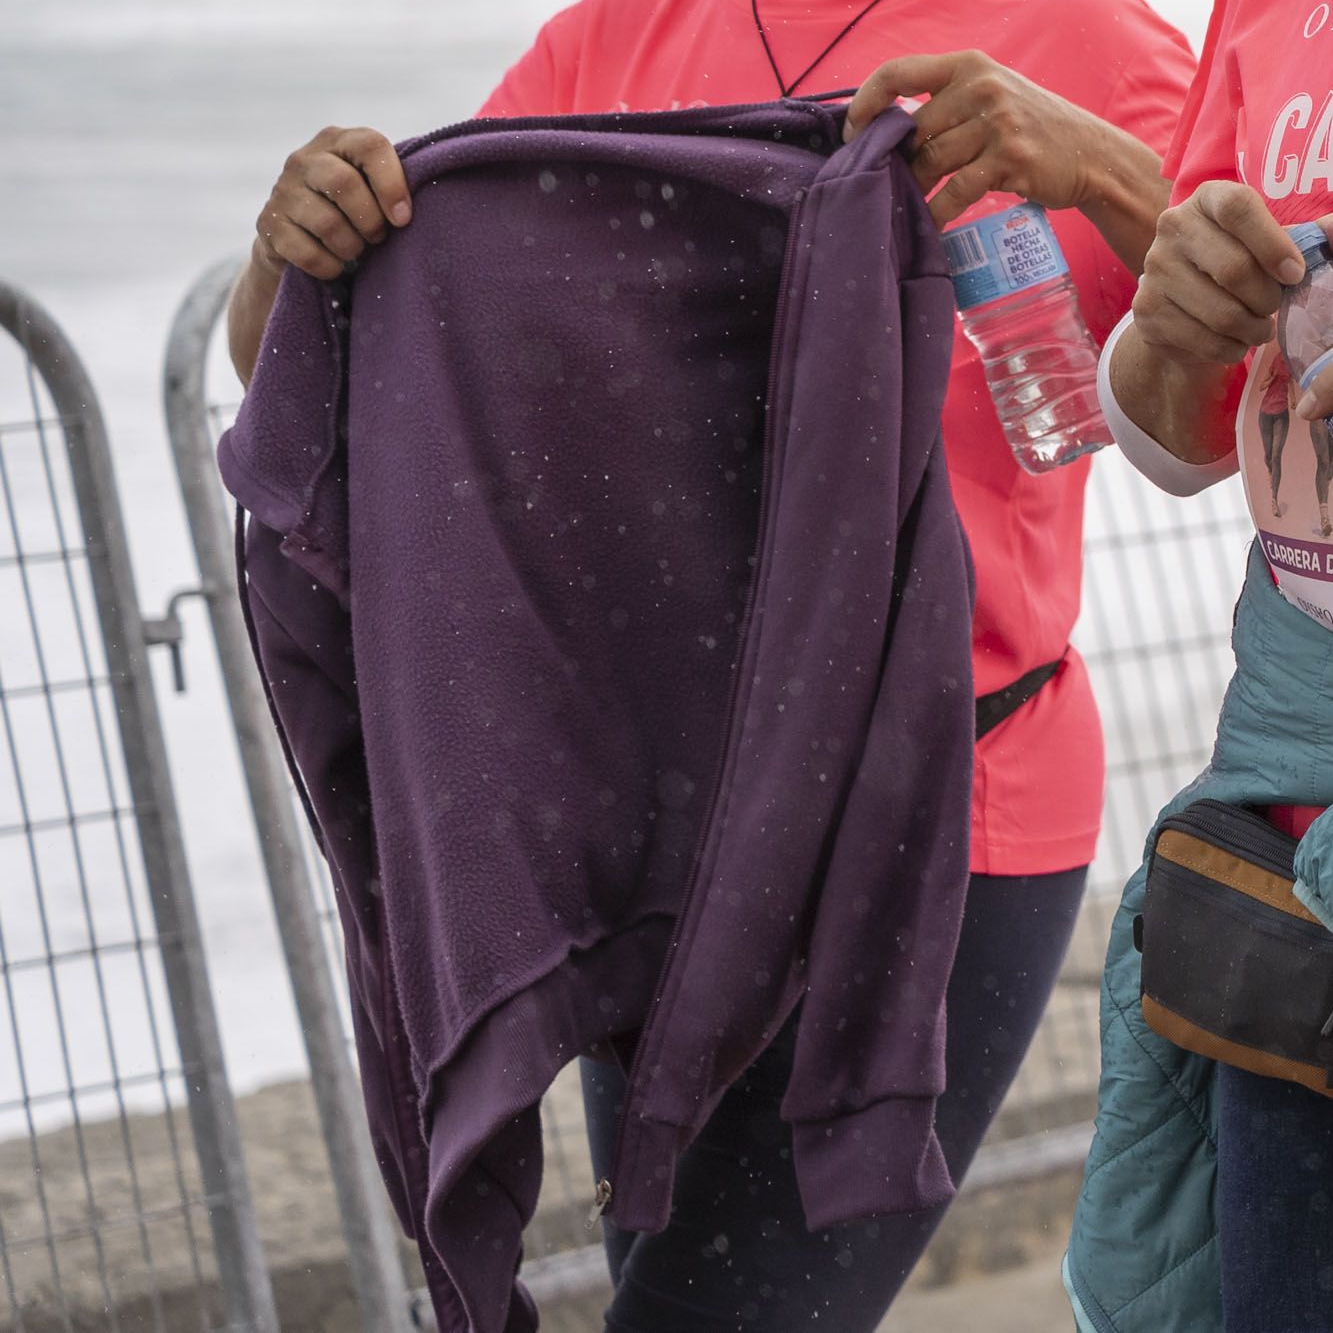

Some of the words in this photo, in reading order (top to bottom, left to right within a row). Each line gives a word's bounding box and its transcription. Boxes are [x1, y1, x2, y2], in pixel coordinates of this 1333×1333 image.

[1003, 226, 1041, 247] BOTELLA
[1011, 237, 1041, 253] HECHA
[1007, 254, 1020, 265] DE
[1022, 243, 1049, 259] OTRAS
[1010, 252, 1053, 274] BOTELLAS
[1266, 540, 1321, 573] CARRERA
